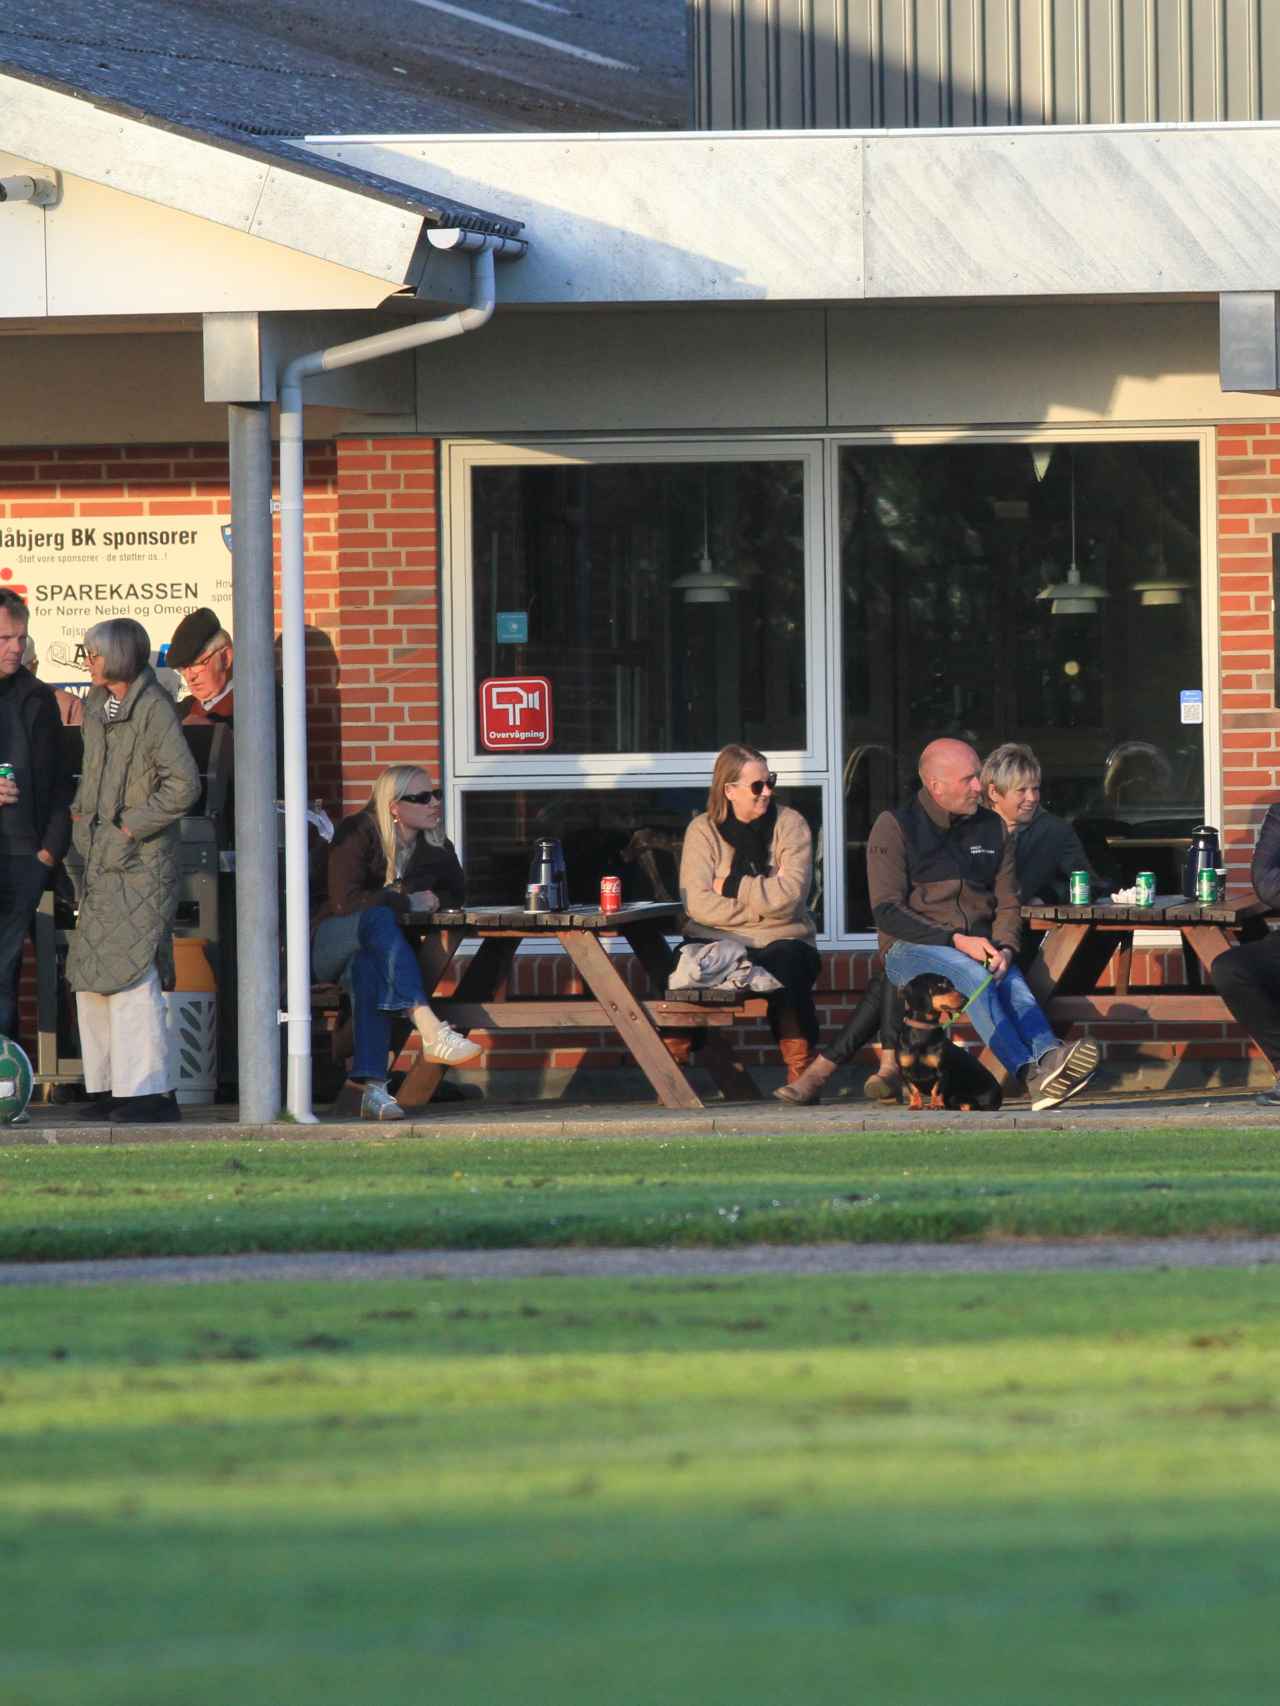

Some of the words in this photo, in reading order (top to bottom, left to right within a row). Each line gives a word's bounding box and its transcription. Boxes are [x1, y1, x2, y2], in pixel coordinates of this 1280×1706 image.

[71, 528, 97, 546] BK
[103, 530, 198, 550] sponsorer
[35, 583, 199, 601] SPAREKASSEN
[35, 605, 52, 616] for
[56, 605, 91, 616] Nørre
[95, 604, 130, 616] Nebel
[134, 606, 150, 617] og
[489, 730, 545, 740] Overvågning
